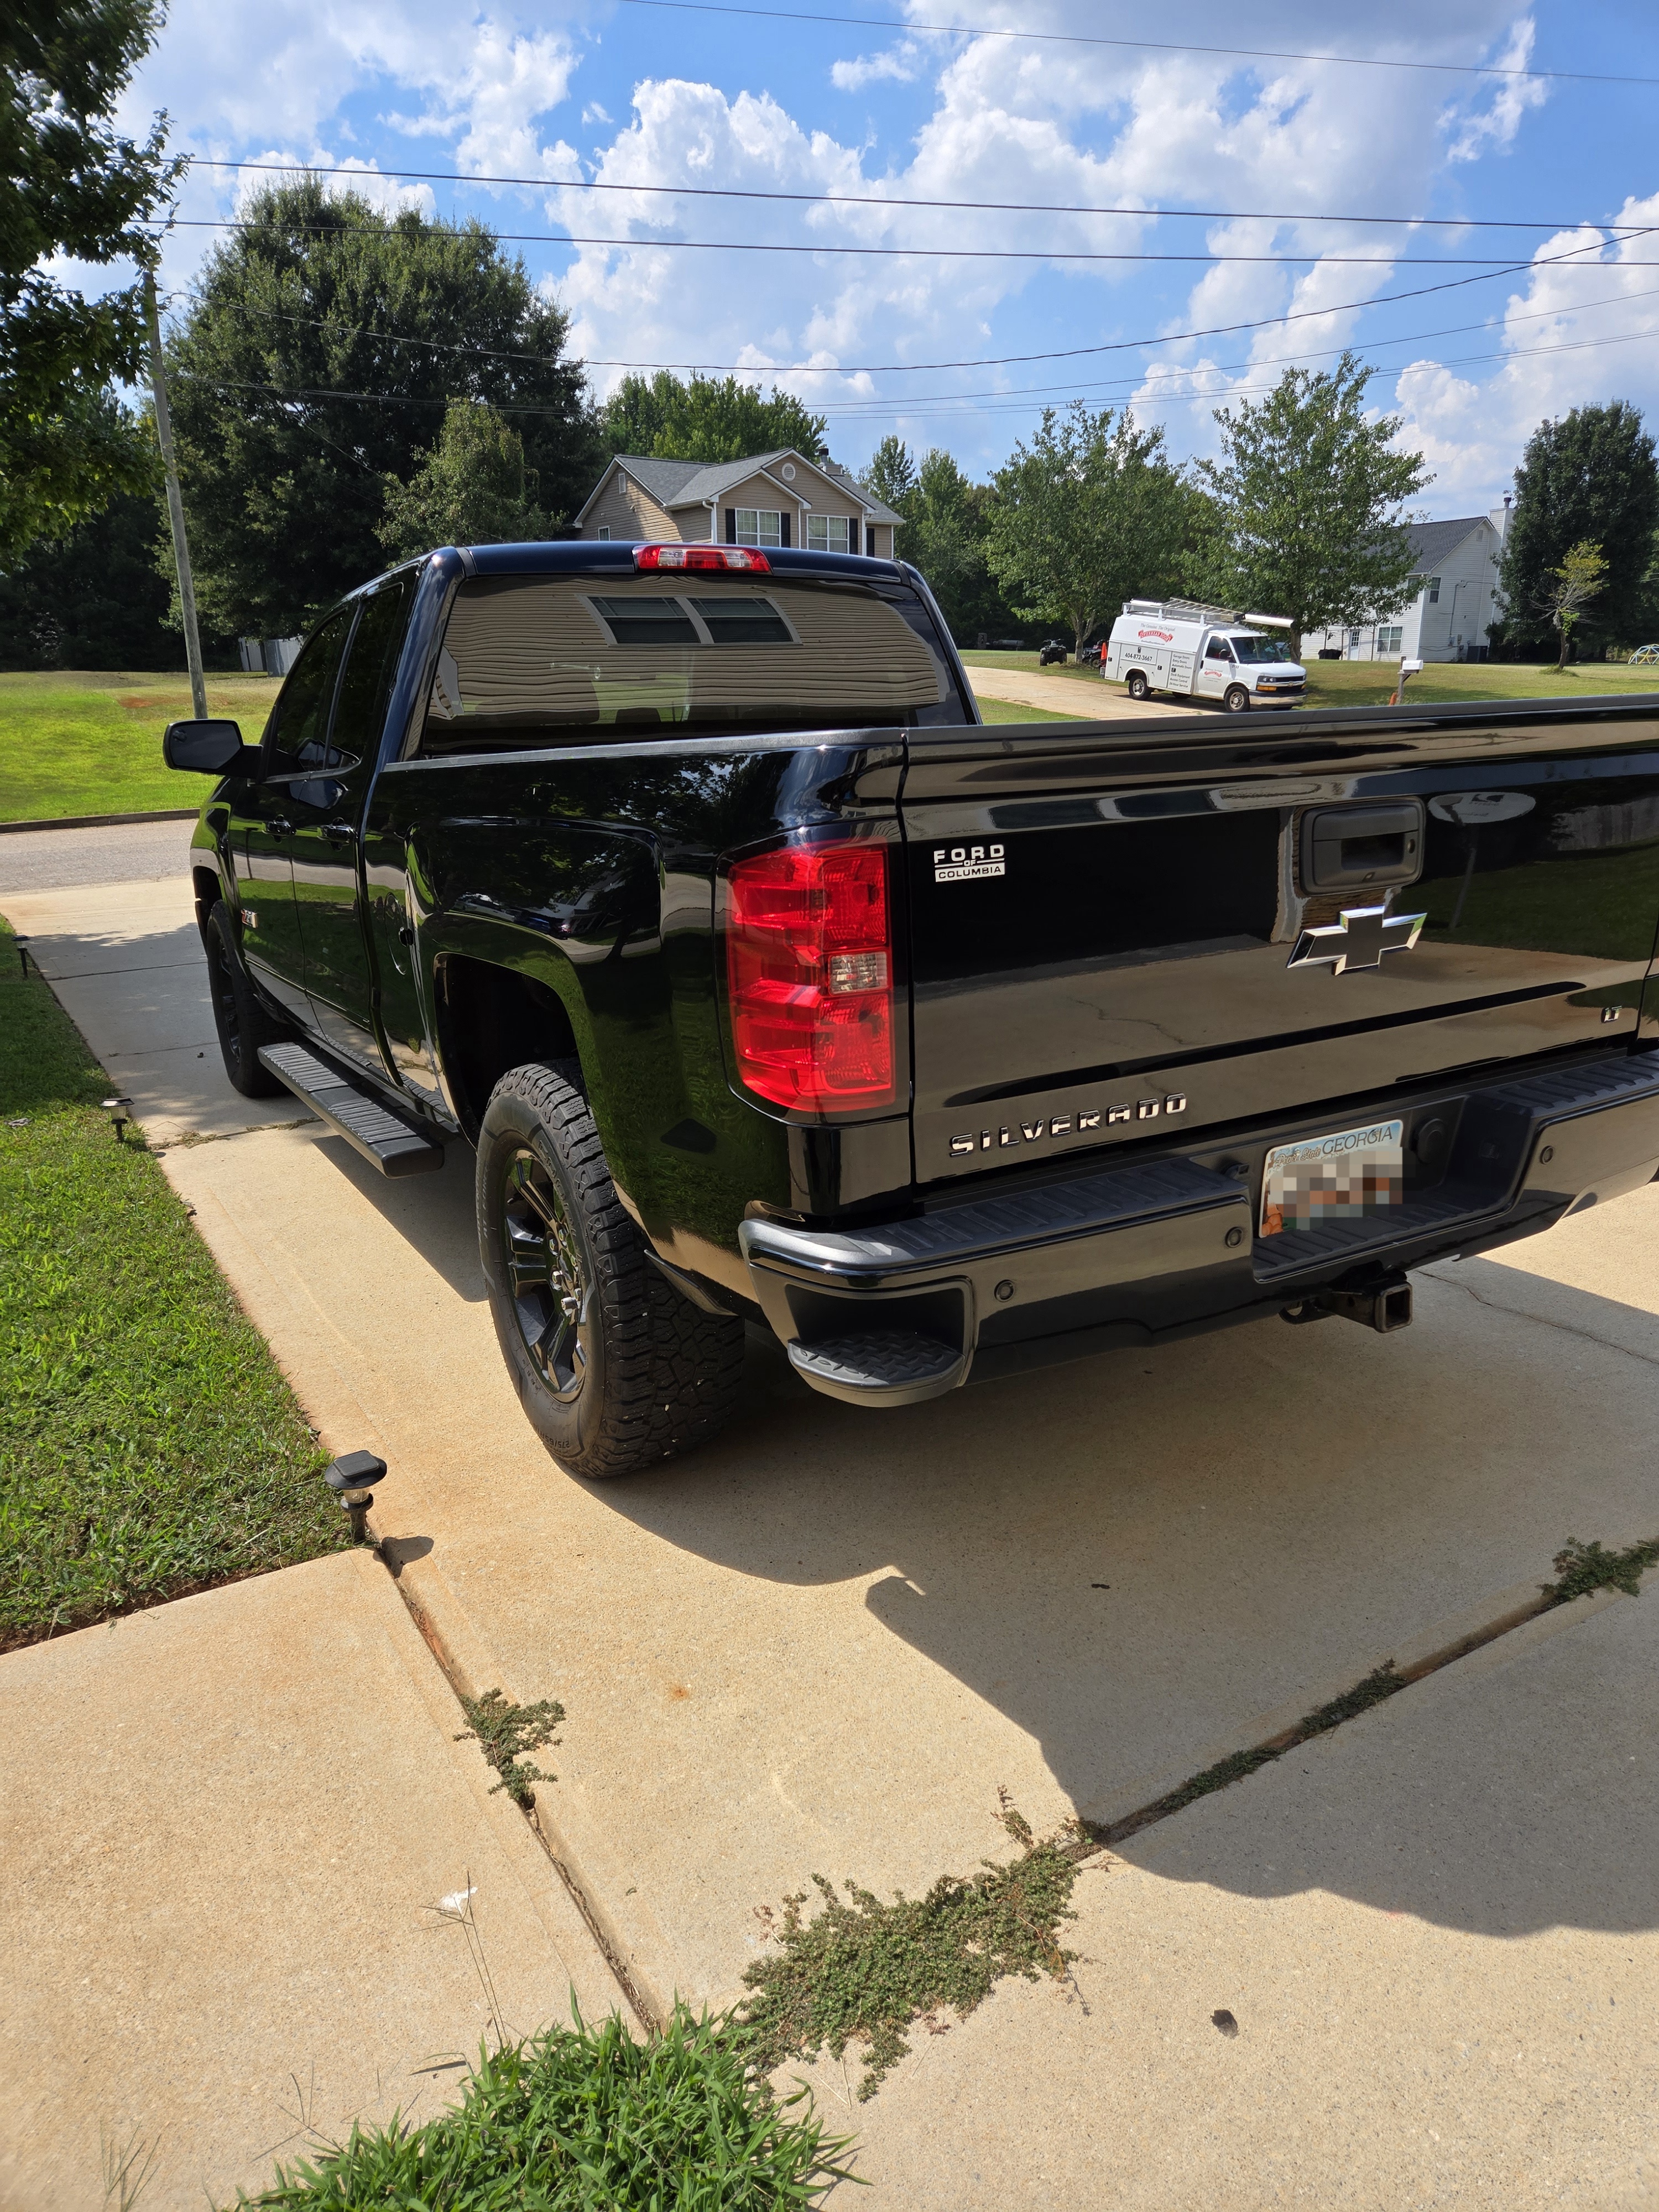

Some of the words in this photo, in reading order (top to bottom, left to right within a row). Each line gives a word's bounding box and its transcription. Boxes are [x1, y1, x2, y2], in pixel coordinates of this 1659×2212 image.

[1125, 653, 1152, 661] 404-872-3667
[933, 844, 1005, 864] FORD
[963, 859, 976, 867] OF
[938, 866, 1001, 879] COLUMBIA
[1601, 1005, 1623, 1023] LT
[949, 1093, 1187, 1157] SILVERADO
[1322, 1126, 1393, 1155] GEORGIA
[1300, 1147, 1321, 1161] State
